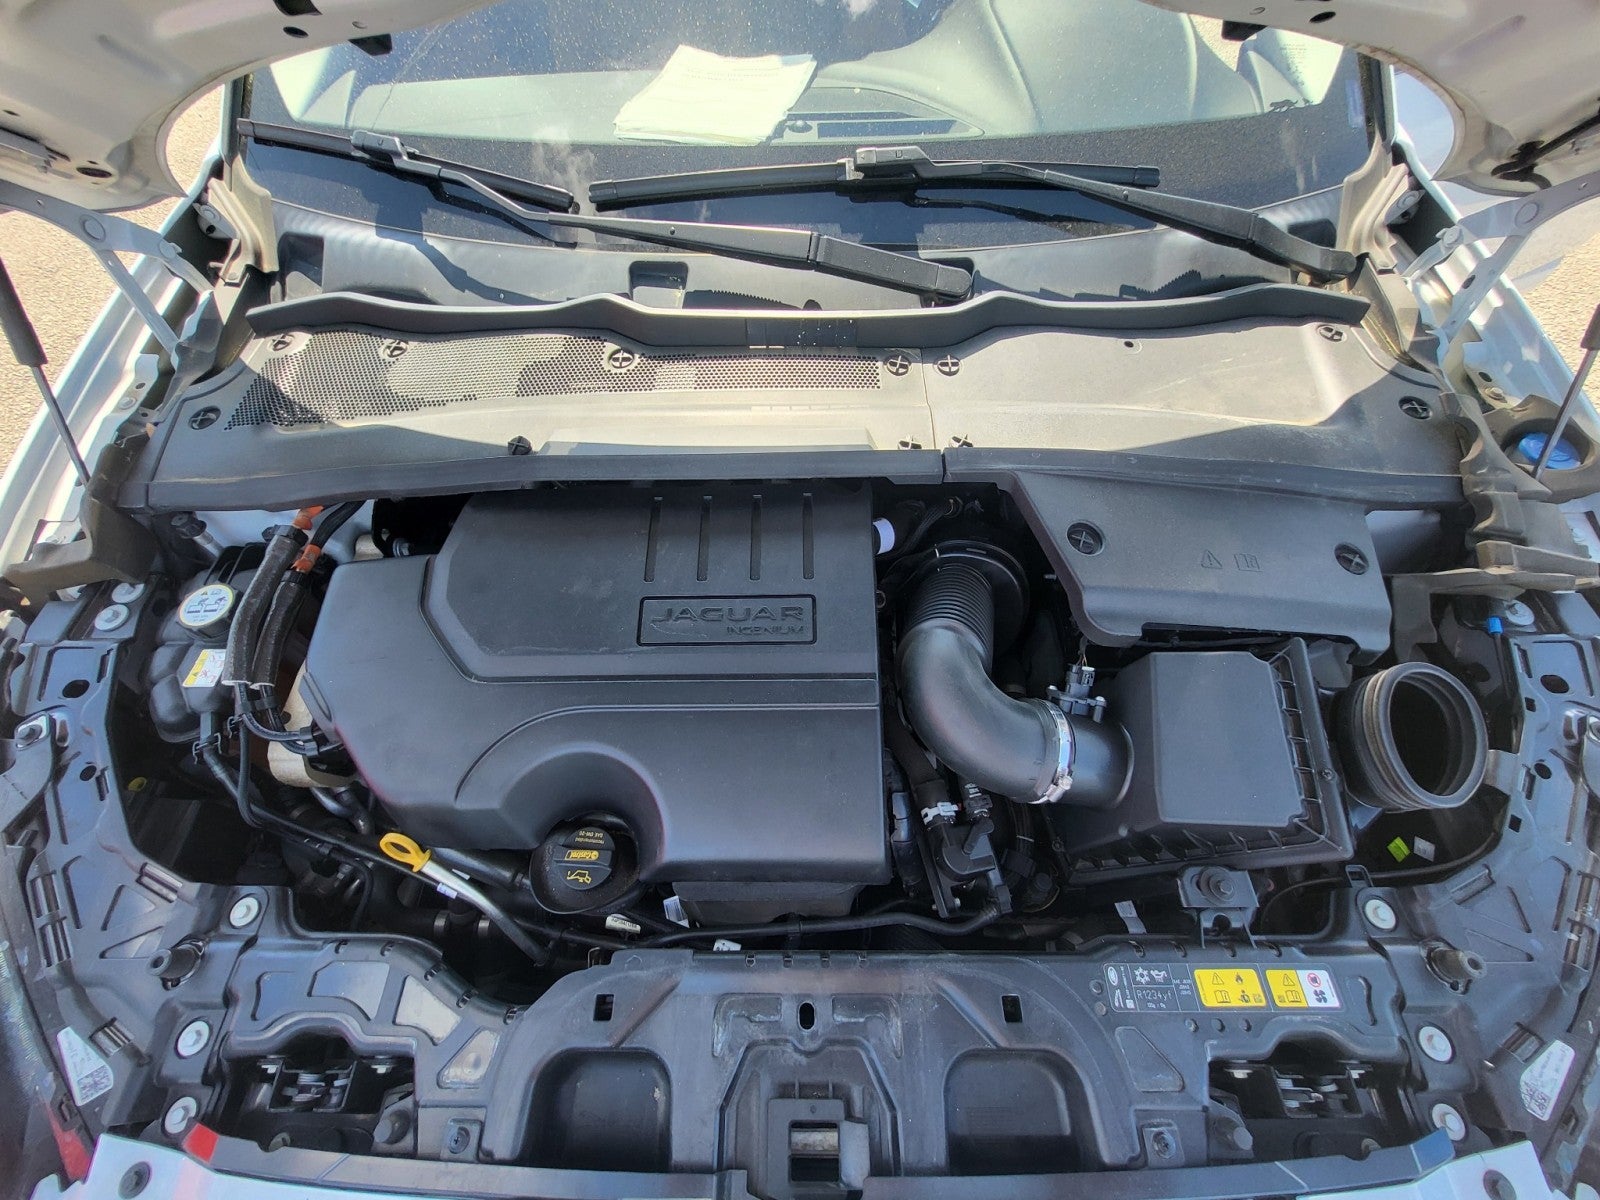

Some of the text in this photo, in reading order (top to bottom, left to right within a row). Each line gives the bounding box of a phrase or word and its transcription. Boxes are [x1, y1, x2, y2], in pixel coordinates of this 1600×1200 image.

[651, 606, 804, 622] JAGUAR
[727, 625, 804, 636] INGENIUM
[1136, 990, 1172, 1001] R1234yf
